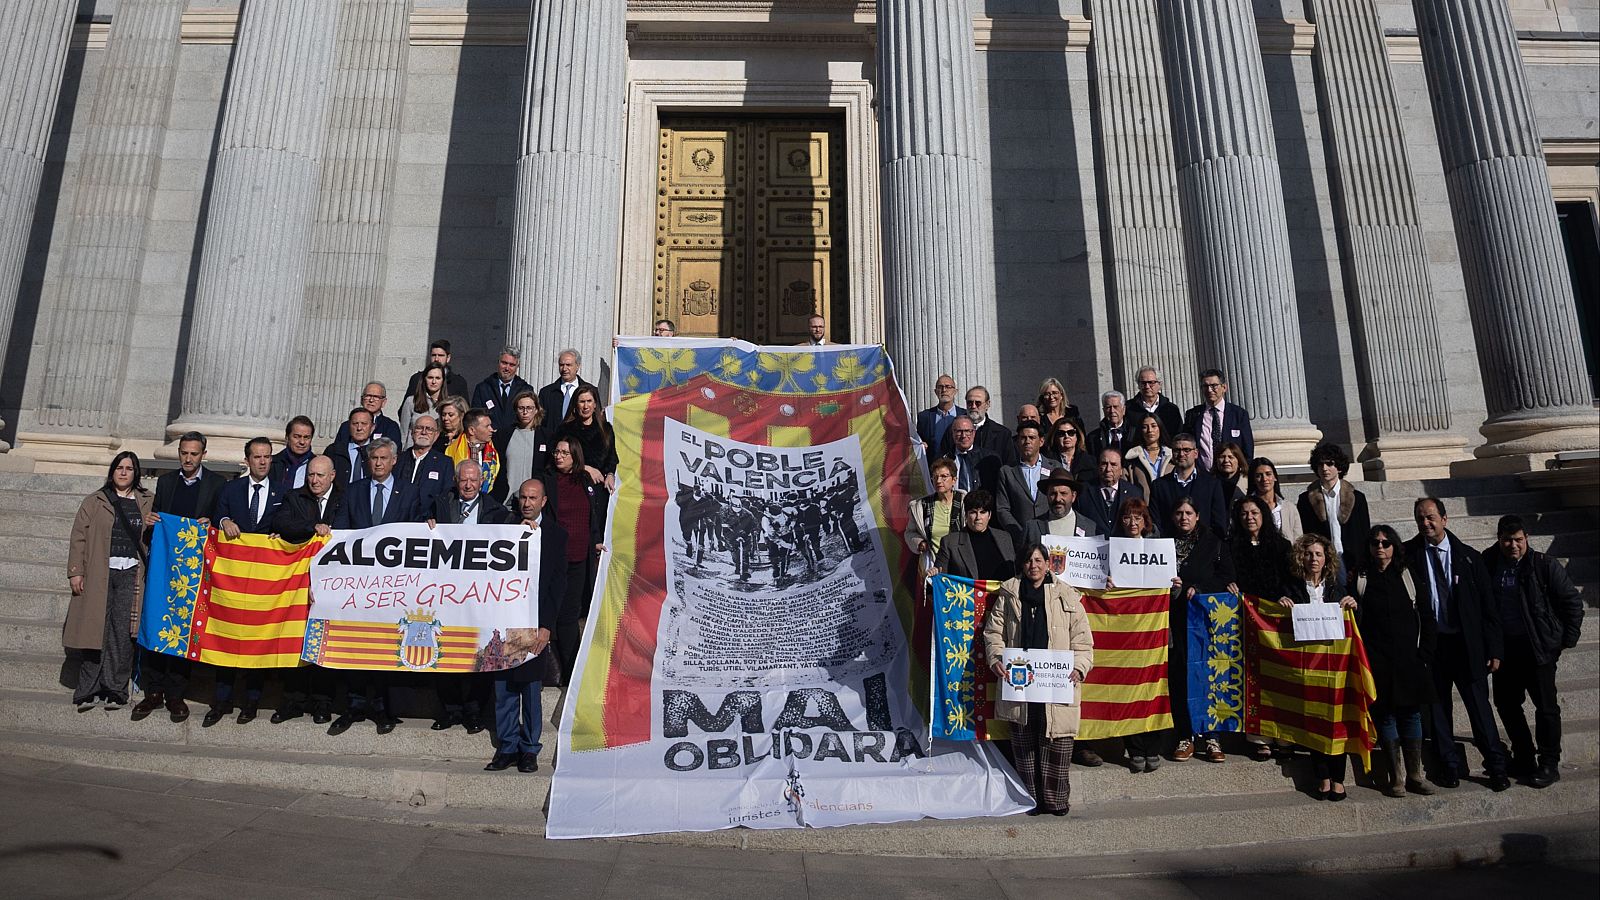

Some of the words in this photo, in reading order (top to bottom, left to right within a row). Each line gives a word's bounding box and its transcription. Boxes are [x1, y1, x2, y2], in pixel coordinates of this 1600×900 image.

[681, 430, 702, 448] EL
[704, 438, 825, 472] POBLE
[679, 450, 853, 490] VALENCIÀ
[317, 531, 533, 572] ALGEMESÍ
[1068, 550, 1108, 561] CATADAU
[1119, 552, 1168, 566] ALBAL
[1069, 561, 1091, 569] RIBERA
[321, 572, 421, 591] TORNAREM
[341, 594, 357, 610] A
[364, 591, 408, 610] SER
[415, 577, 530, 608] GRANS!
[746, 663, 798, 671] VILAMARXANT,
[1034, 661, 1070, 671] LLOMBAI
[662, 672, 893, 738] MAI
[728, 809, 781, 823] juristes
